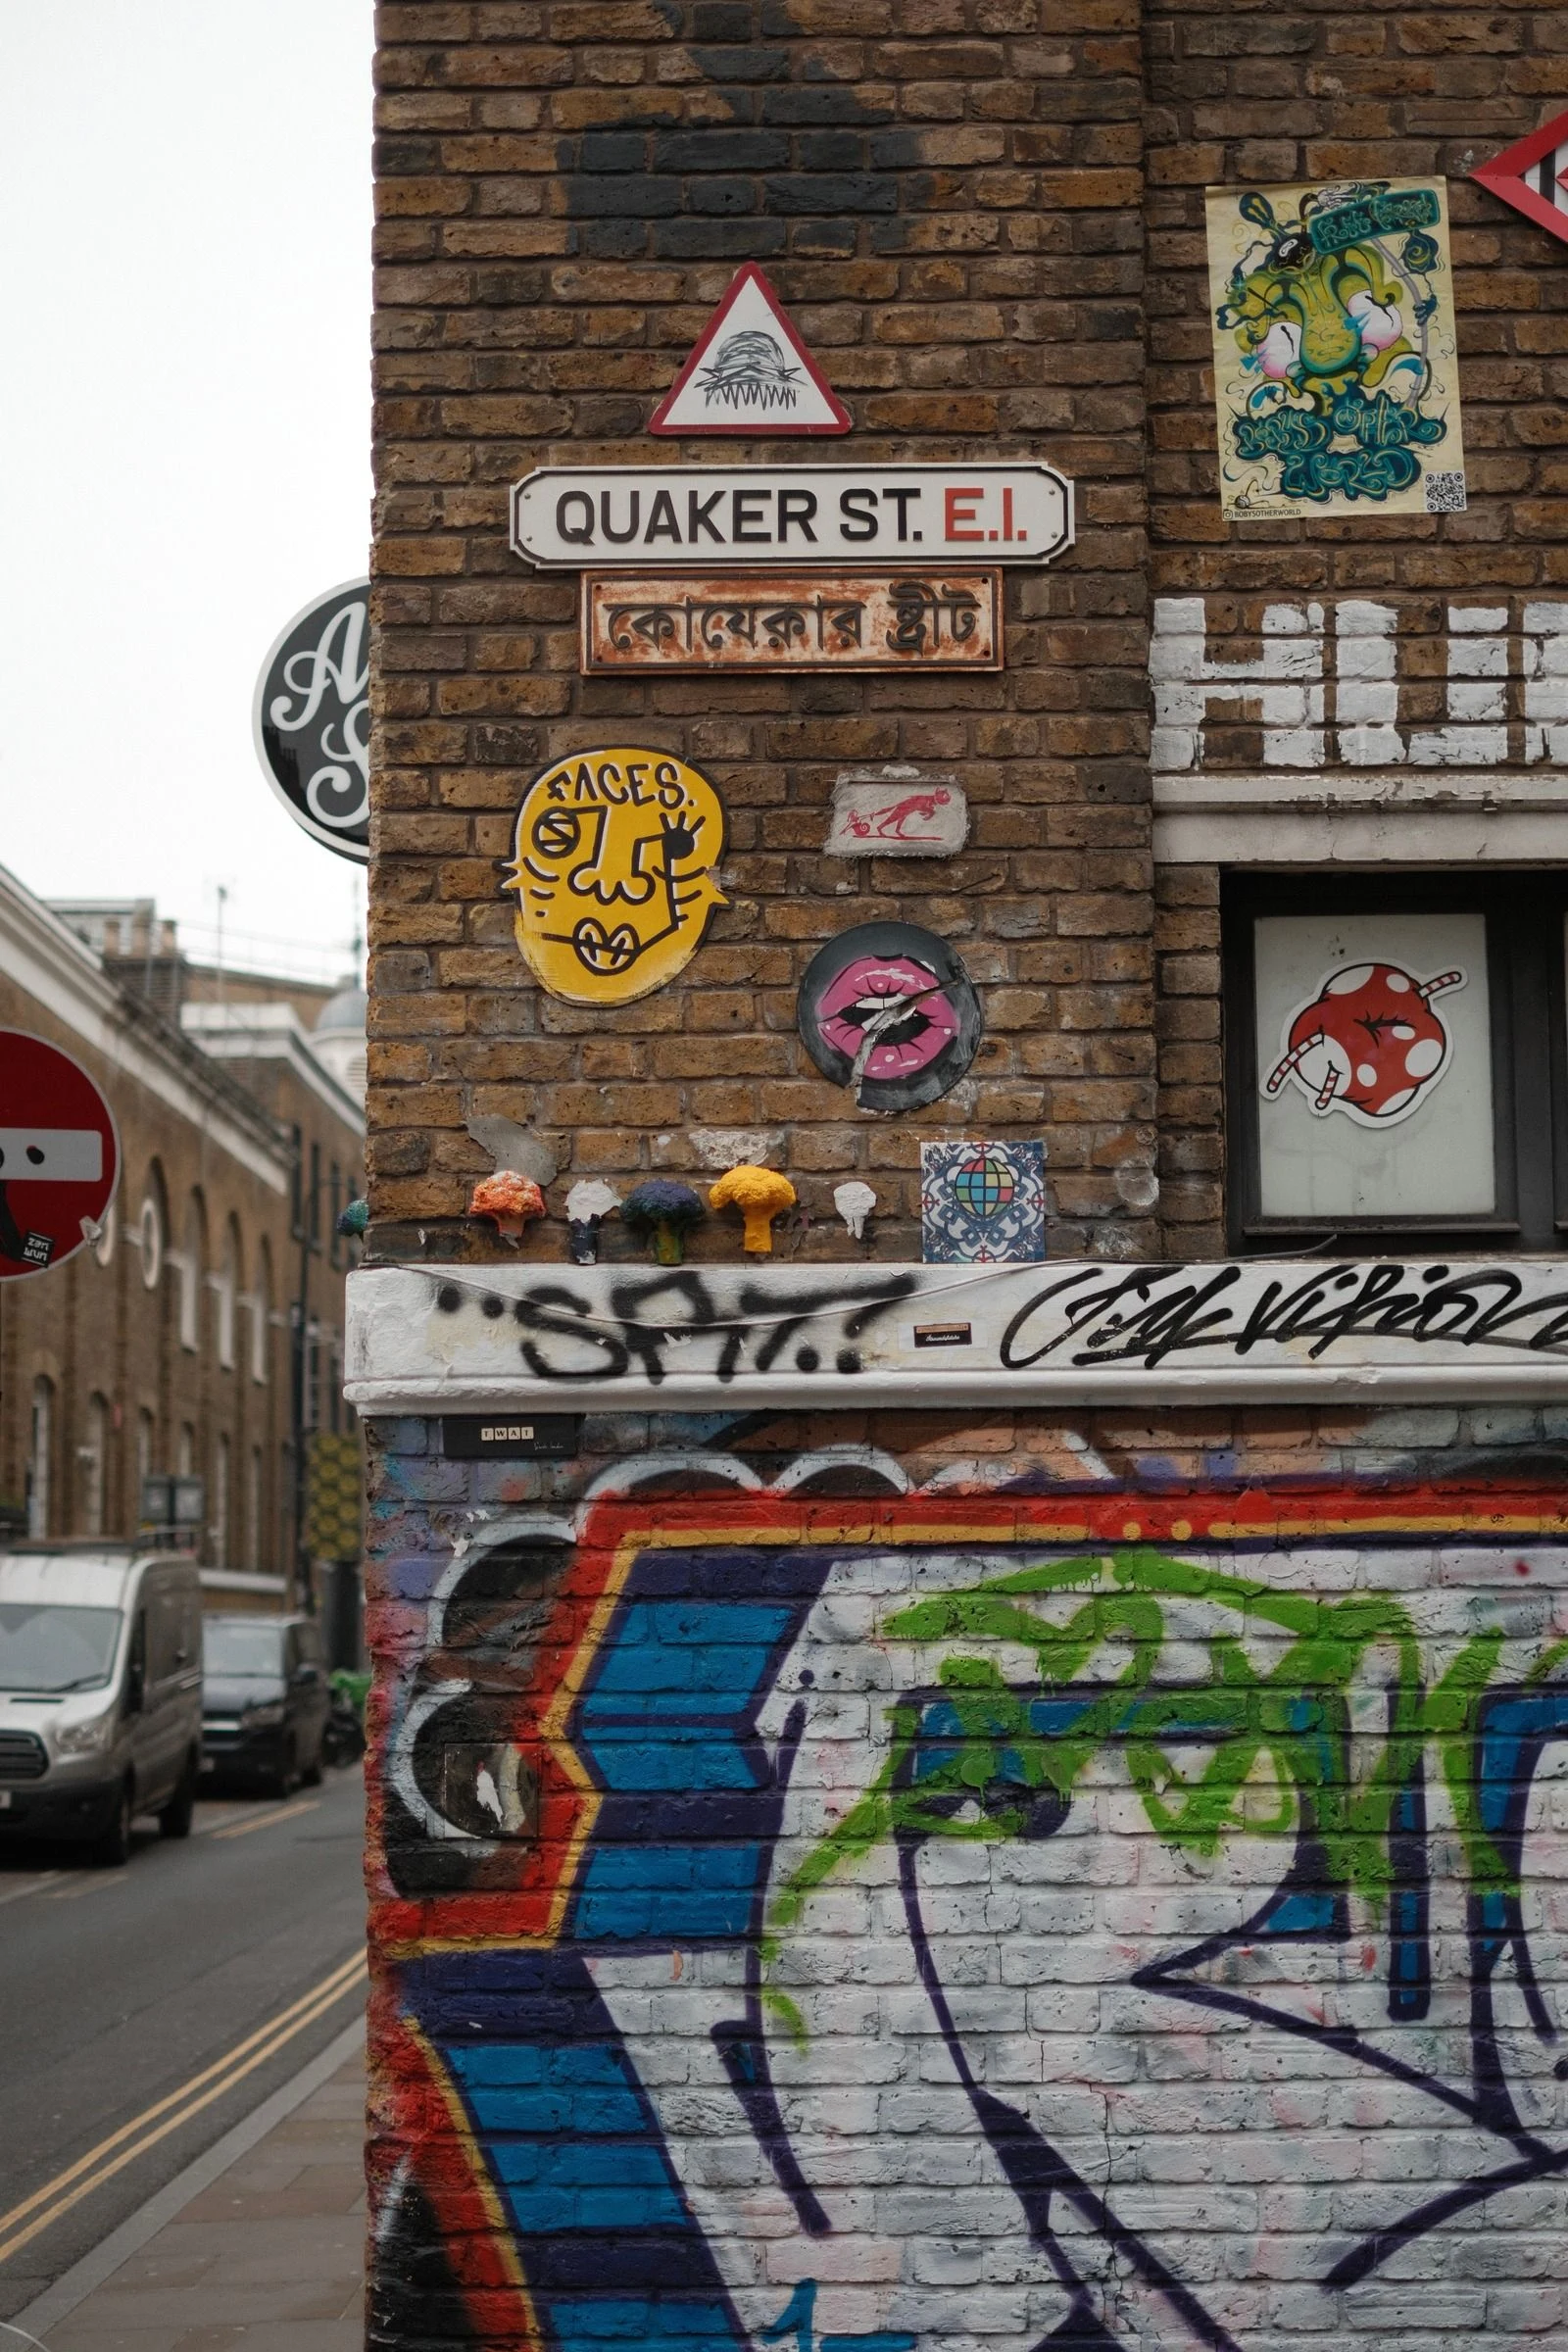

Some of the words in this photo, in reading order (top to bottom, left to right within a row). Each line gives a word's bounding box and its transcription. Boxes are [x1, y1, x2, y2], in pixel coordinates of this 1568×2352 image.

[556, 489, 818, 545] QUAKER
[839, 488, 923, 541] ST.
[1235, 509, 1301, 518] BOBYSOTHERWORLD
[482, 1428, 532, 1440] TWAT
